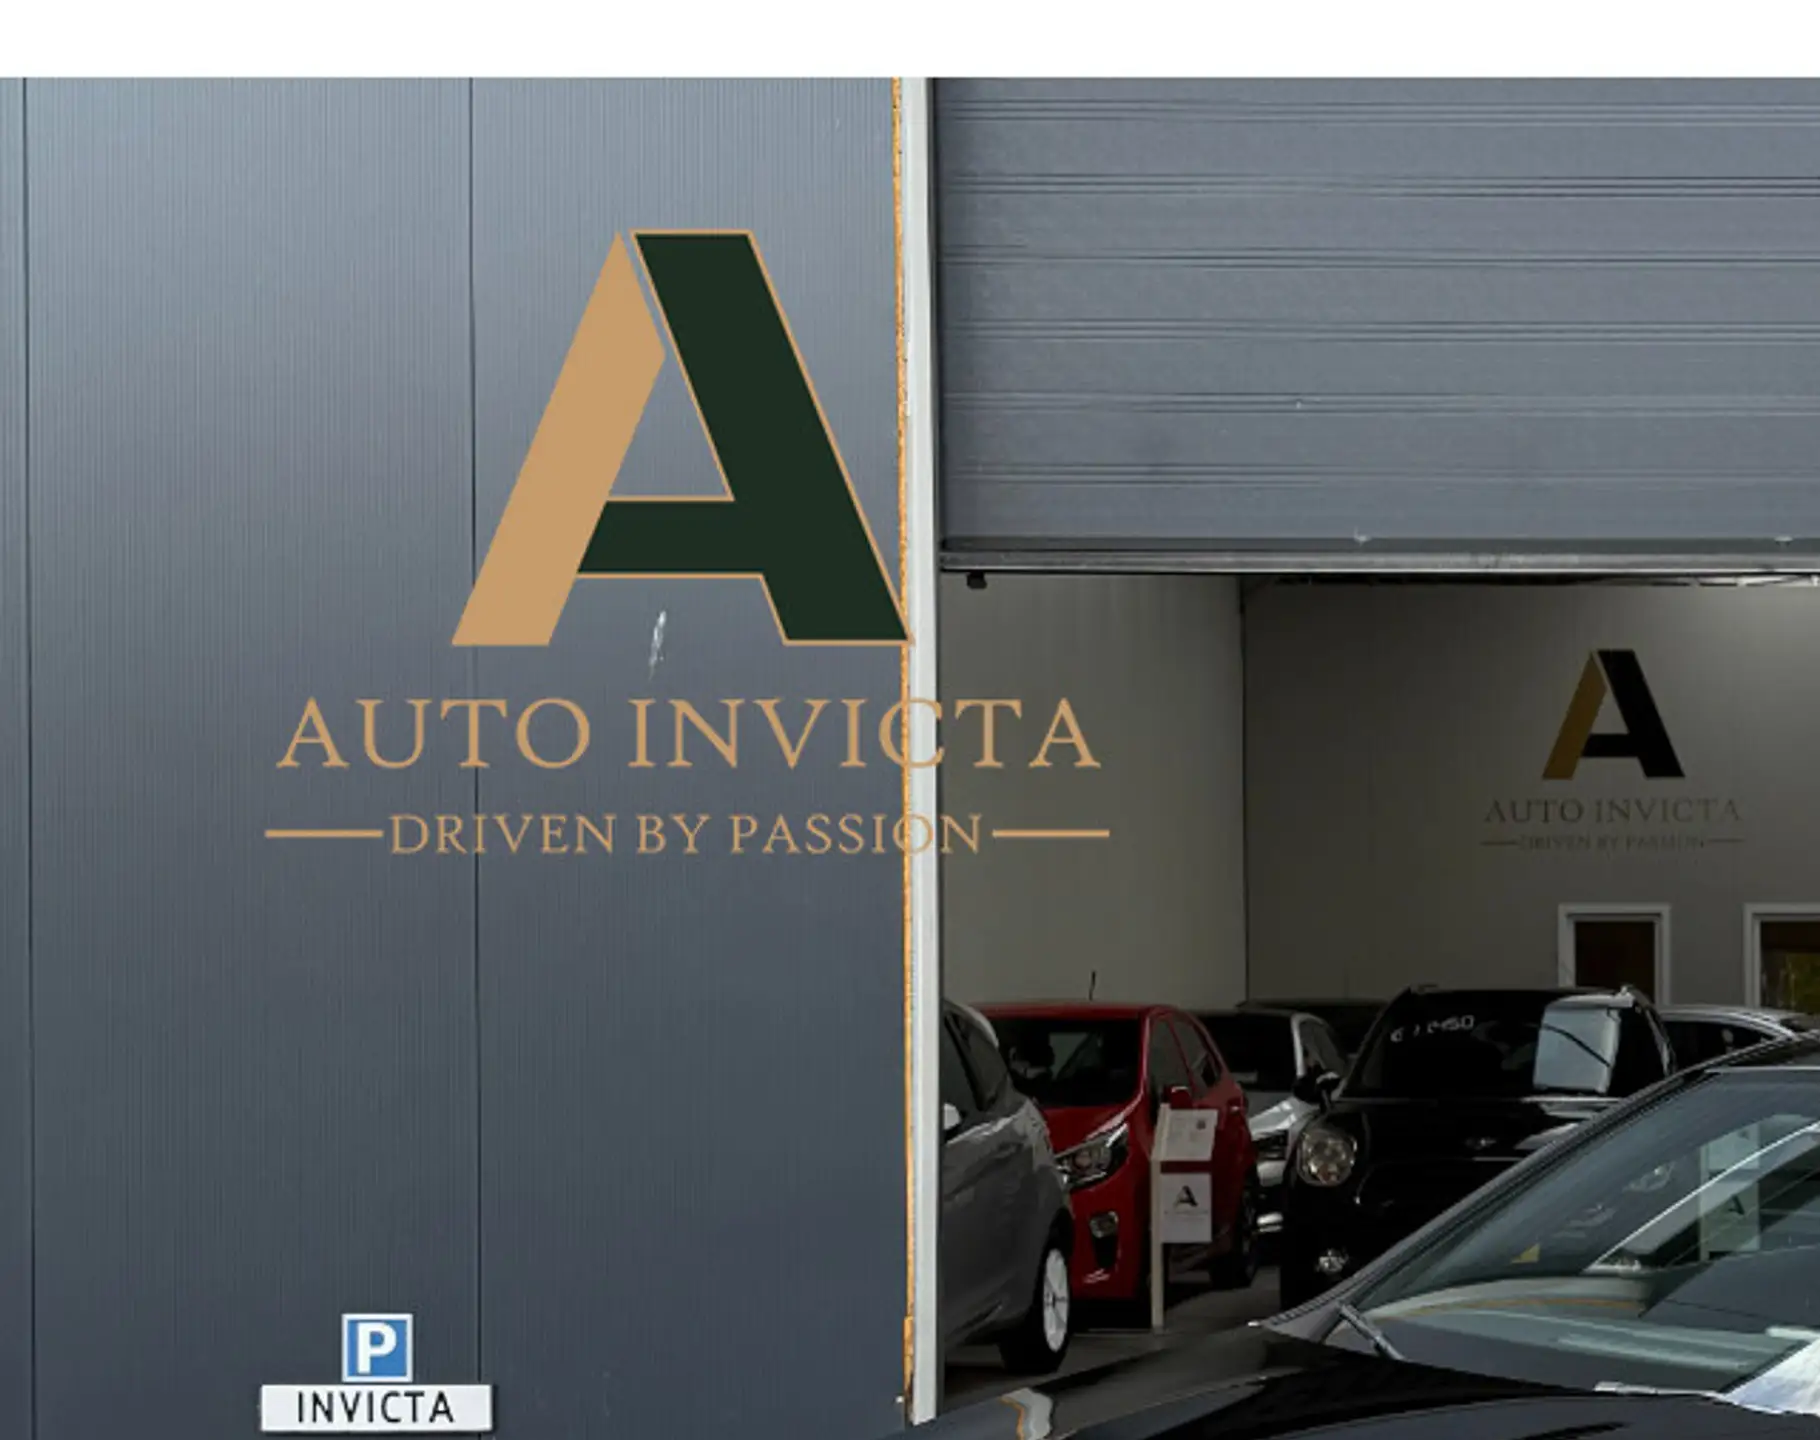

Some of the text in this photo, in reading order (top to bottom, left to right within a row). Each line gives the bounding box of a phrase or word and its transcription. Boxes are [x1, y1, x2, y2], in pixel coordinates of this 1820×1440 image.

[1484, 797, 1742, 823] AUTO INVICTA
[297, 1390, 455, 1424] INVICTA
